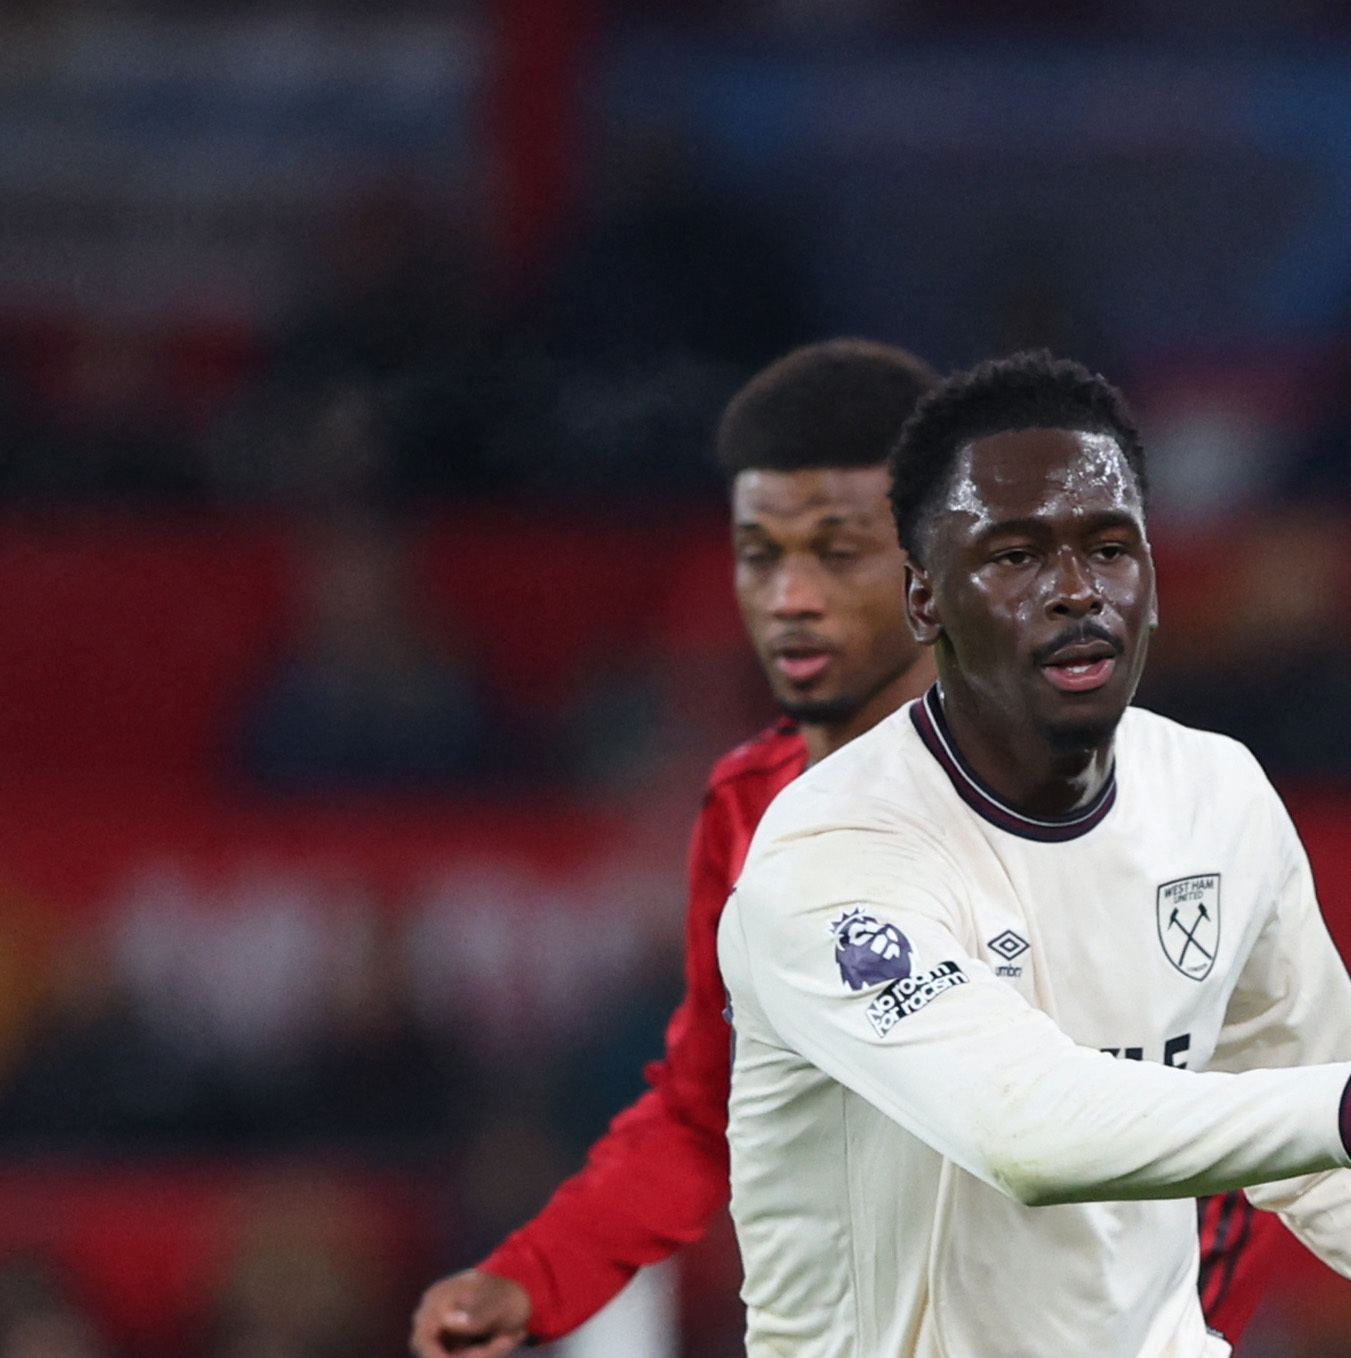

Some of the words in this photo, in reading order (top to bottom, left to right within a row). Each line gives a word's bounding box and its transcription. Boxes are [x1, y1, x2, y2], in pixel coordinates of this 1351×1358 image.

[1164, 880, 1189, 899] WEST
[1191, 878, 1214, 890] HAM
[1173, 889, 1204, 905] UNITED
[865, 994, 895, 1025] No
[891, 963, 951, 1002] room
[900, 971, 970, 1016] racism
